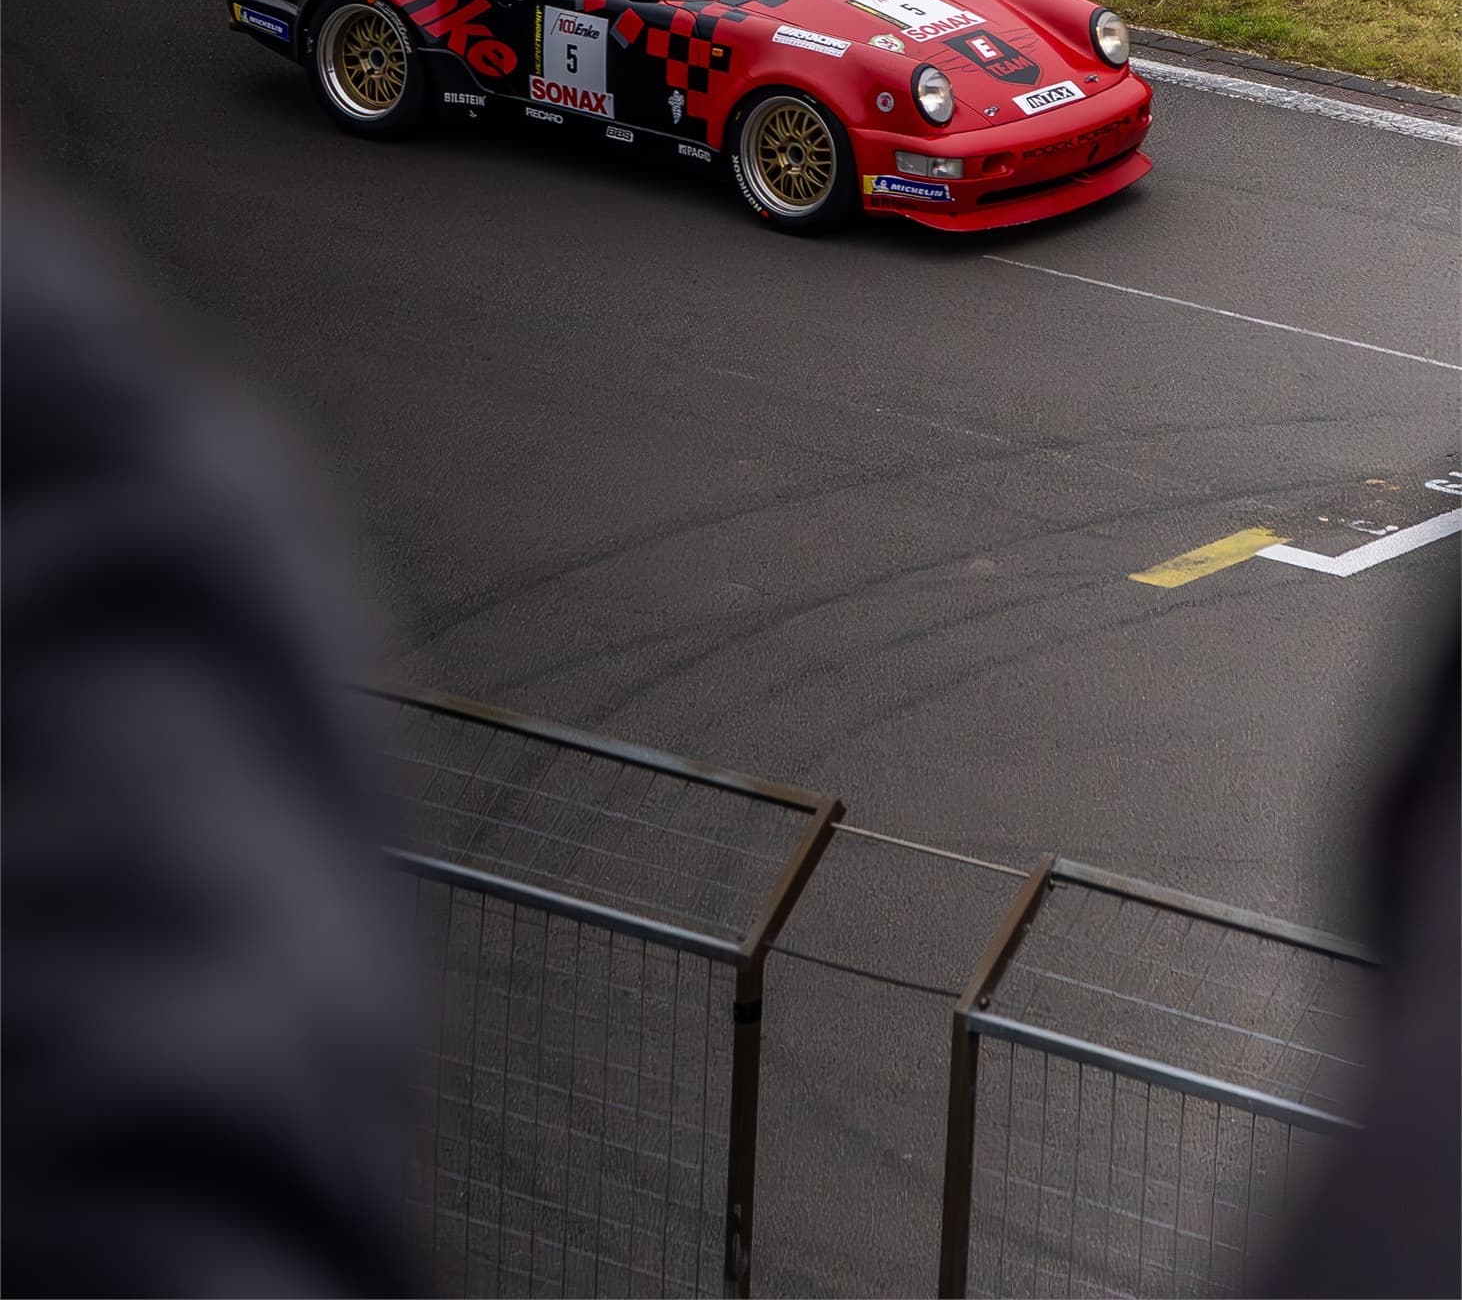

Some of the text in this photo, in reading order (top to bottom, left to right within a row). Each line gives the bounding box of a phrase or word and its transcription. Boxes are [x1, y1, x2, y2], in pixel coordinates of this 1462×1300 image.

[899, 3, 926, 16] 5
[907, 13, 979, 40] SONAX
[971, 38, 997, 58] E
[566, 44, 578, 74] 5
[986, 57, 1033, 76] TEAM
[531, 78, 608, 115] SONAX
[1027, 86, 1074, 108] INTAX
[526, 107, 564, 124] RECARO
[607, 127, 632, 141] BBS
[890, 183, 943, 197] MICHELIN
